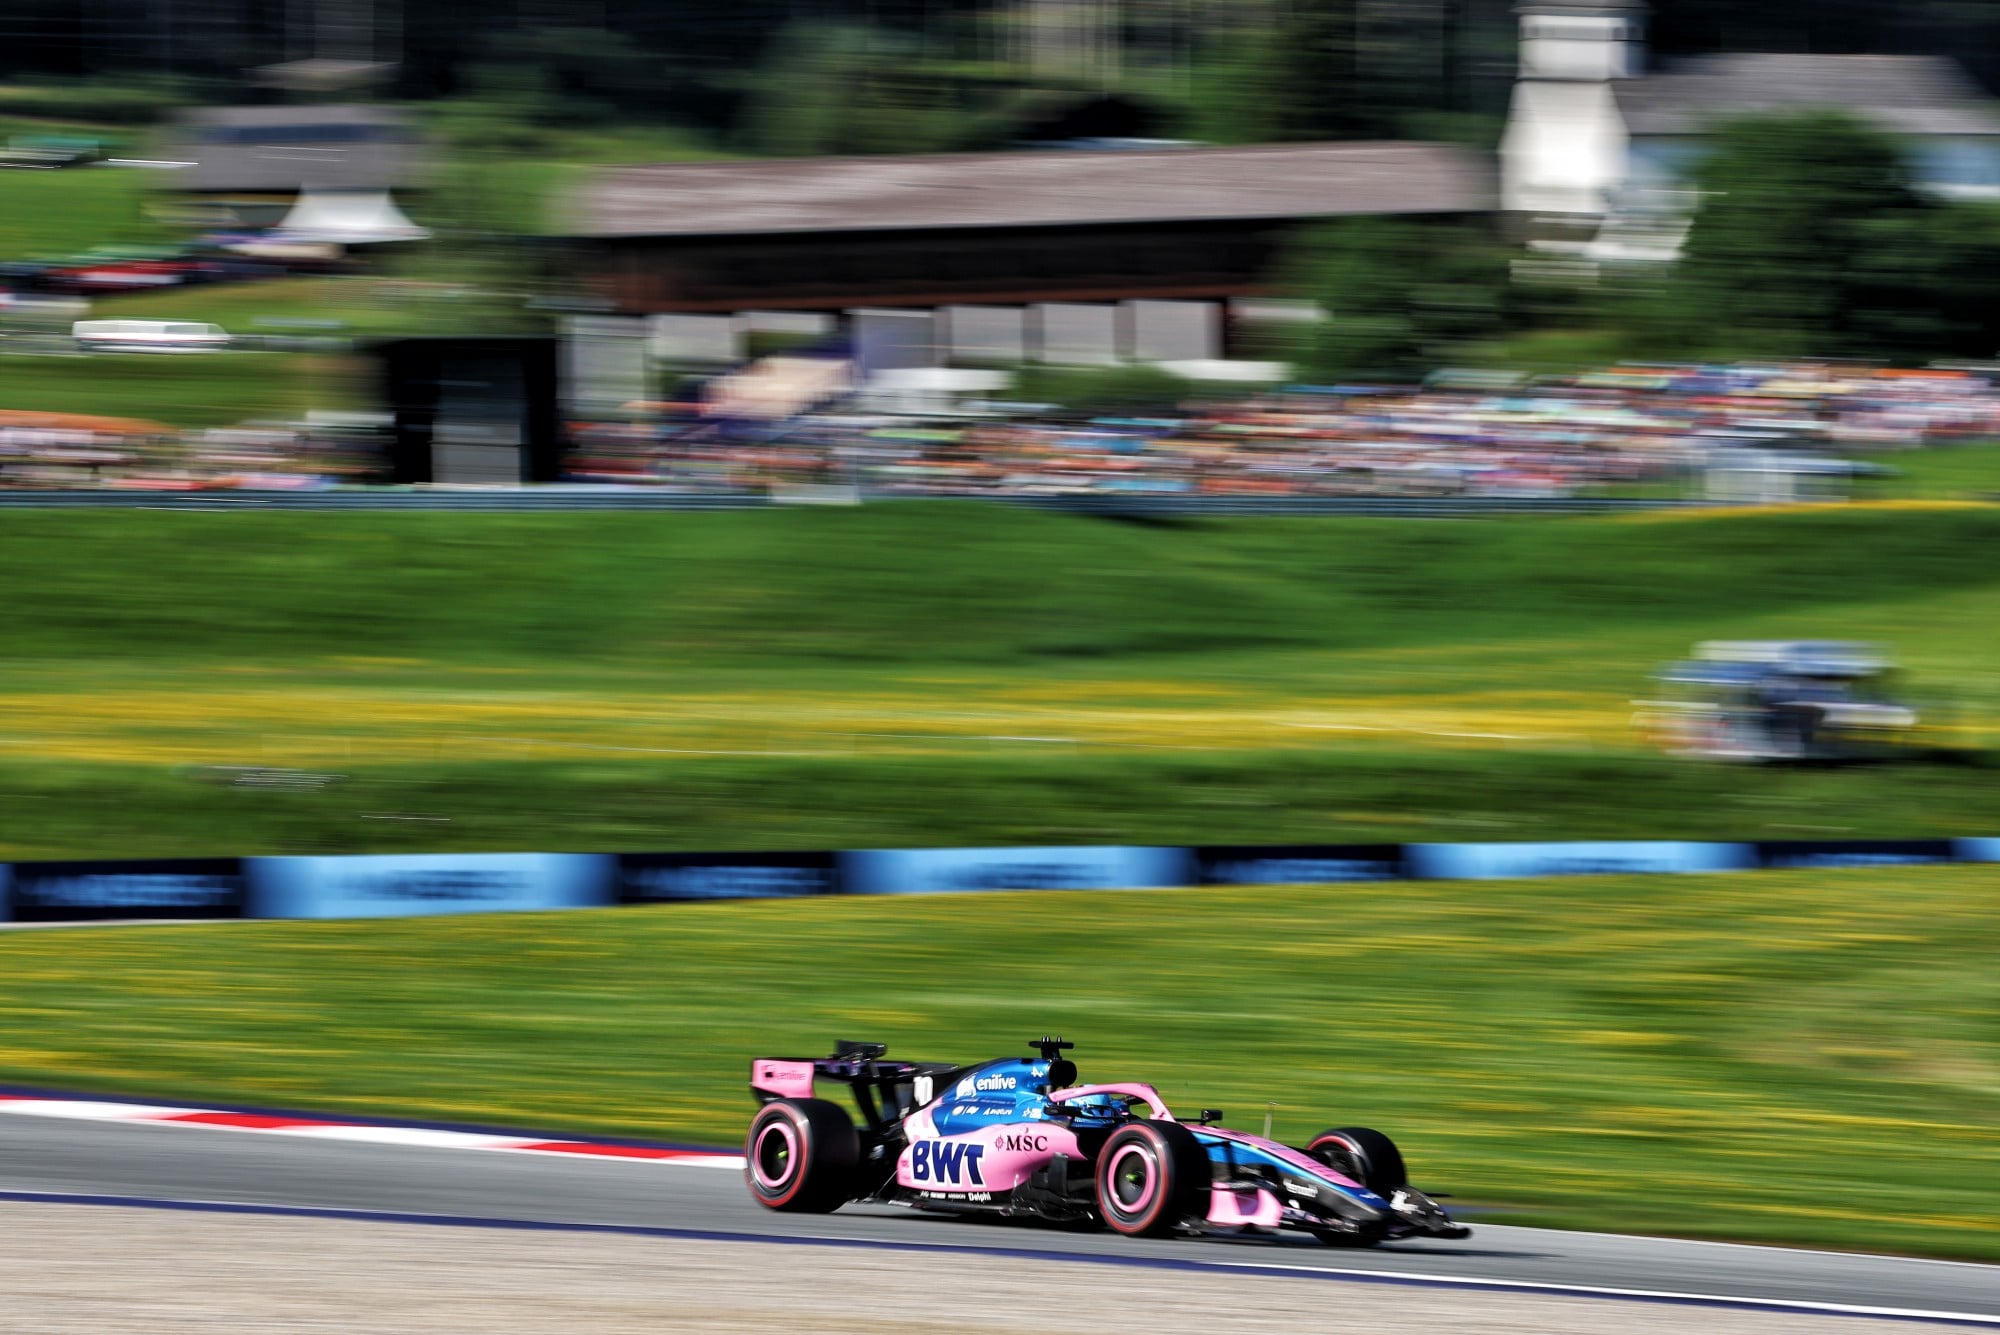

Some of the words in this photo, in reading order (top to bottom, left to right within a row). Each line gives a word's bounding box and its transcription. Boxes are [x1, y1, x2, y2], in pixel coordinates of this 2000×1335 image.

[976, 1074, 1016, 1091] enilive
[1006, 1135, 1048, 1151] MSC
[912, 1140, 985, 1186] BWT
[968, 1192, 992, 1203] Delphi
